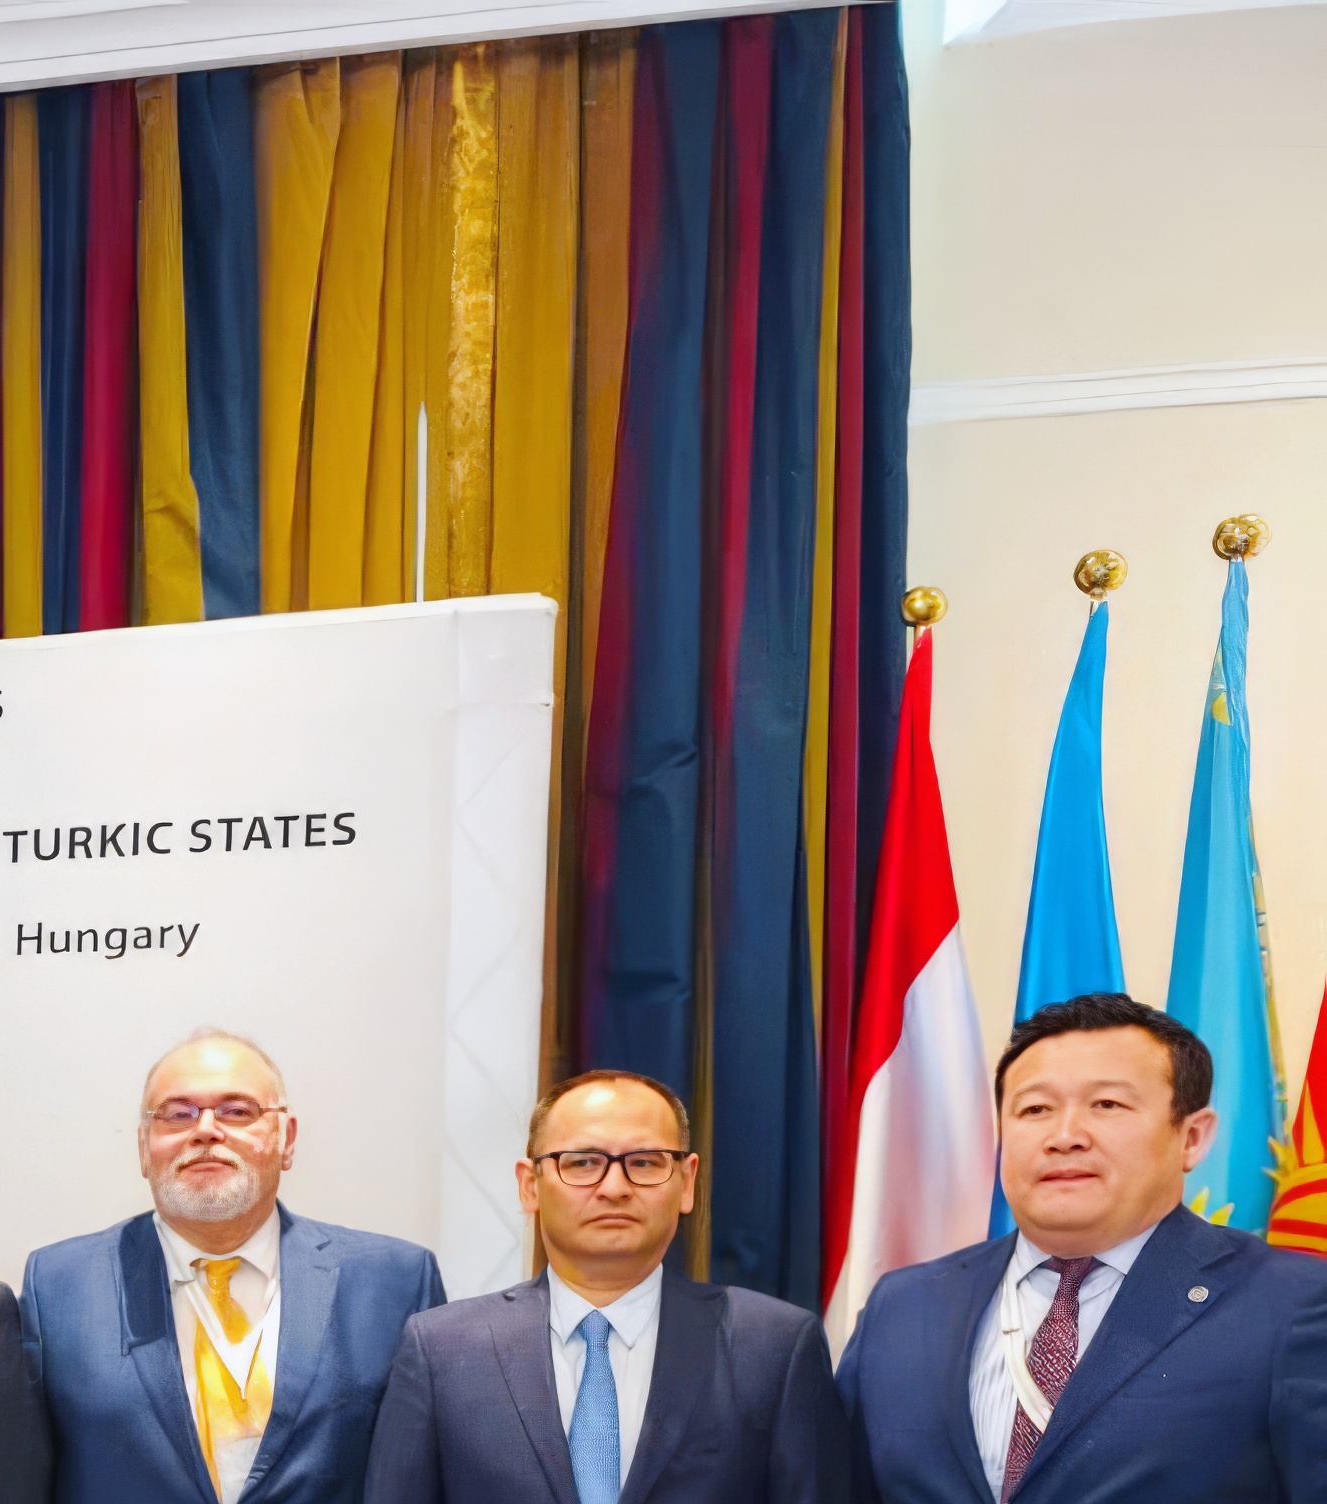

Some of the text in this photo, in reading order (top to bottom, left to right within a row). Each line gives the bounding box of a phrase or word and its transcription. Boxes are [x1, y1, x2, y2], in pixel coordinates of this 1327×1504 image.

[1, 820, 175, 865] TURKIC
[187, 810, 358, 855] STATES
[15, 920, 202, 961] Hungary
